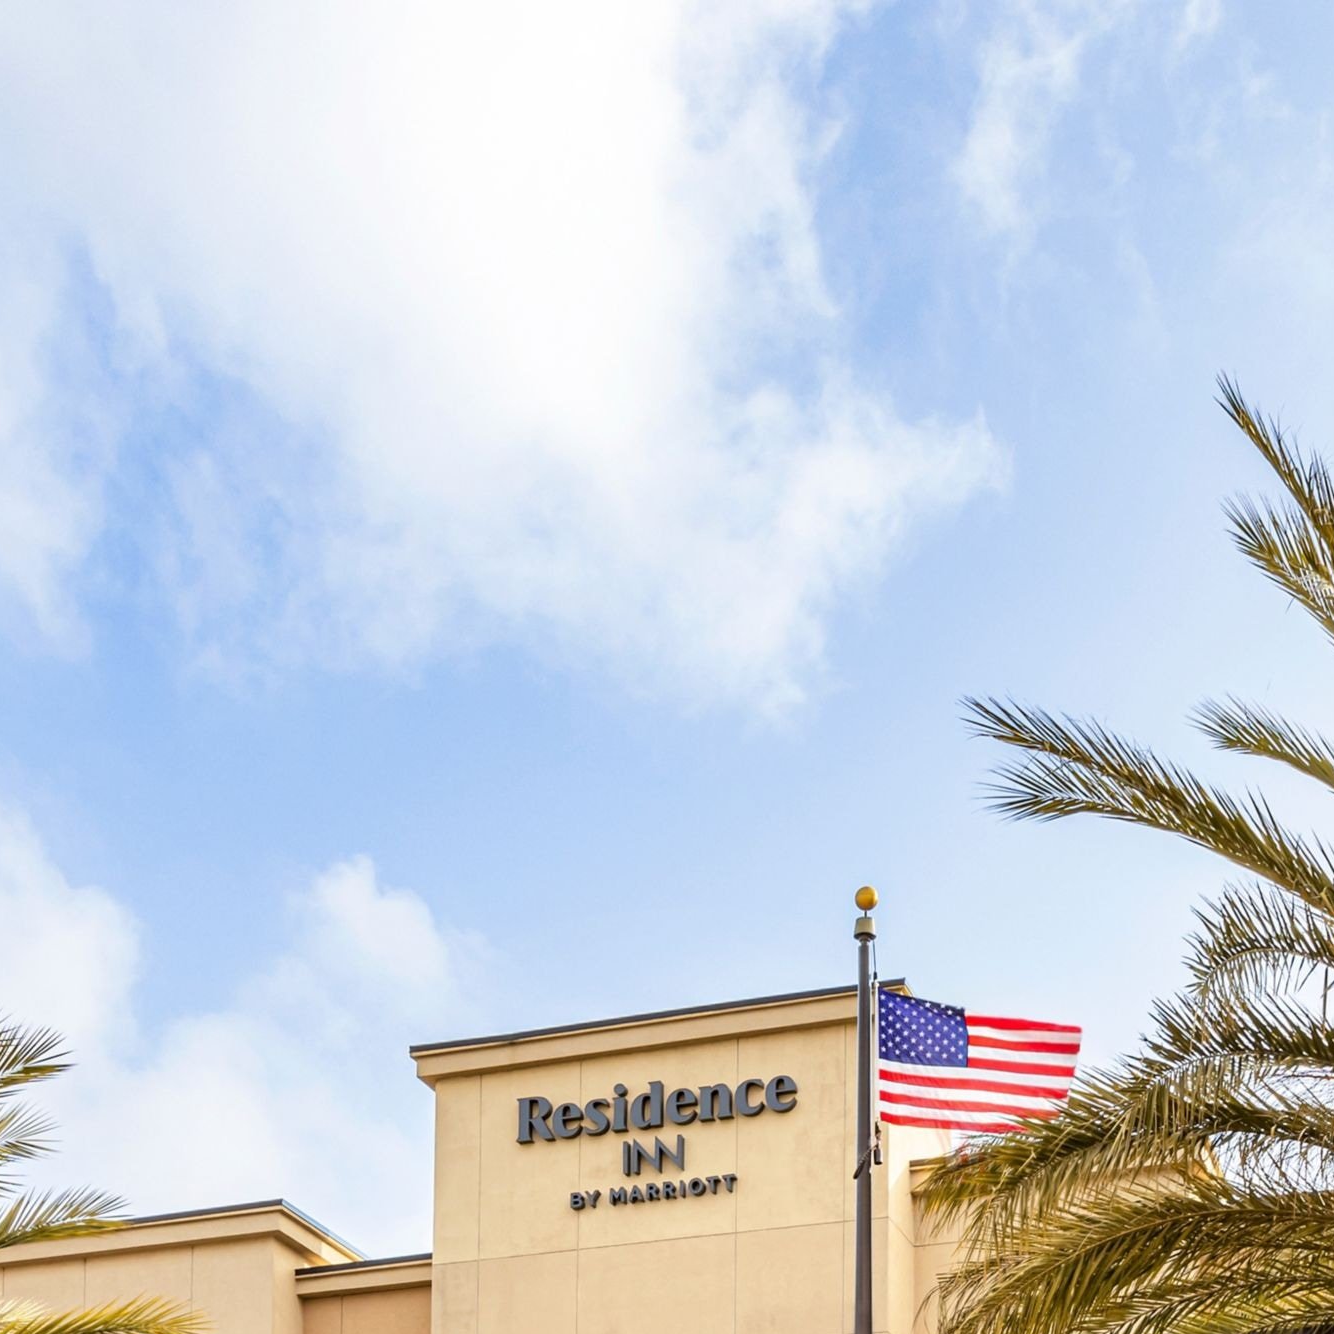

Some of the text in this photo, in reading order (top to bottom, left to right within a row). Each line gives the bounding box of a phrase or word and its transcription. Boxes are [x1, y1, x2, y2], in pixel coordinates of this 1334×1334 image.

[516, 1075, 798, 1144] Residence
[623, 1134, 685, 1177] INN
[570, 1174, 737, 1210] BY MARRIOTT
